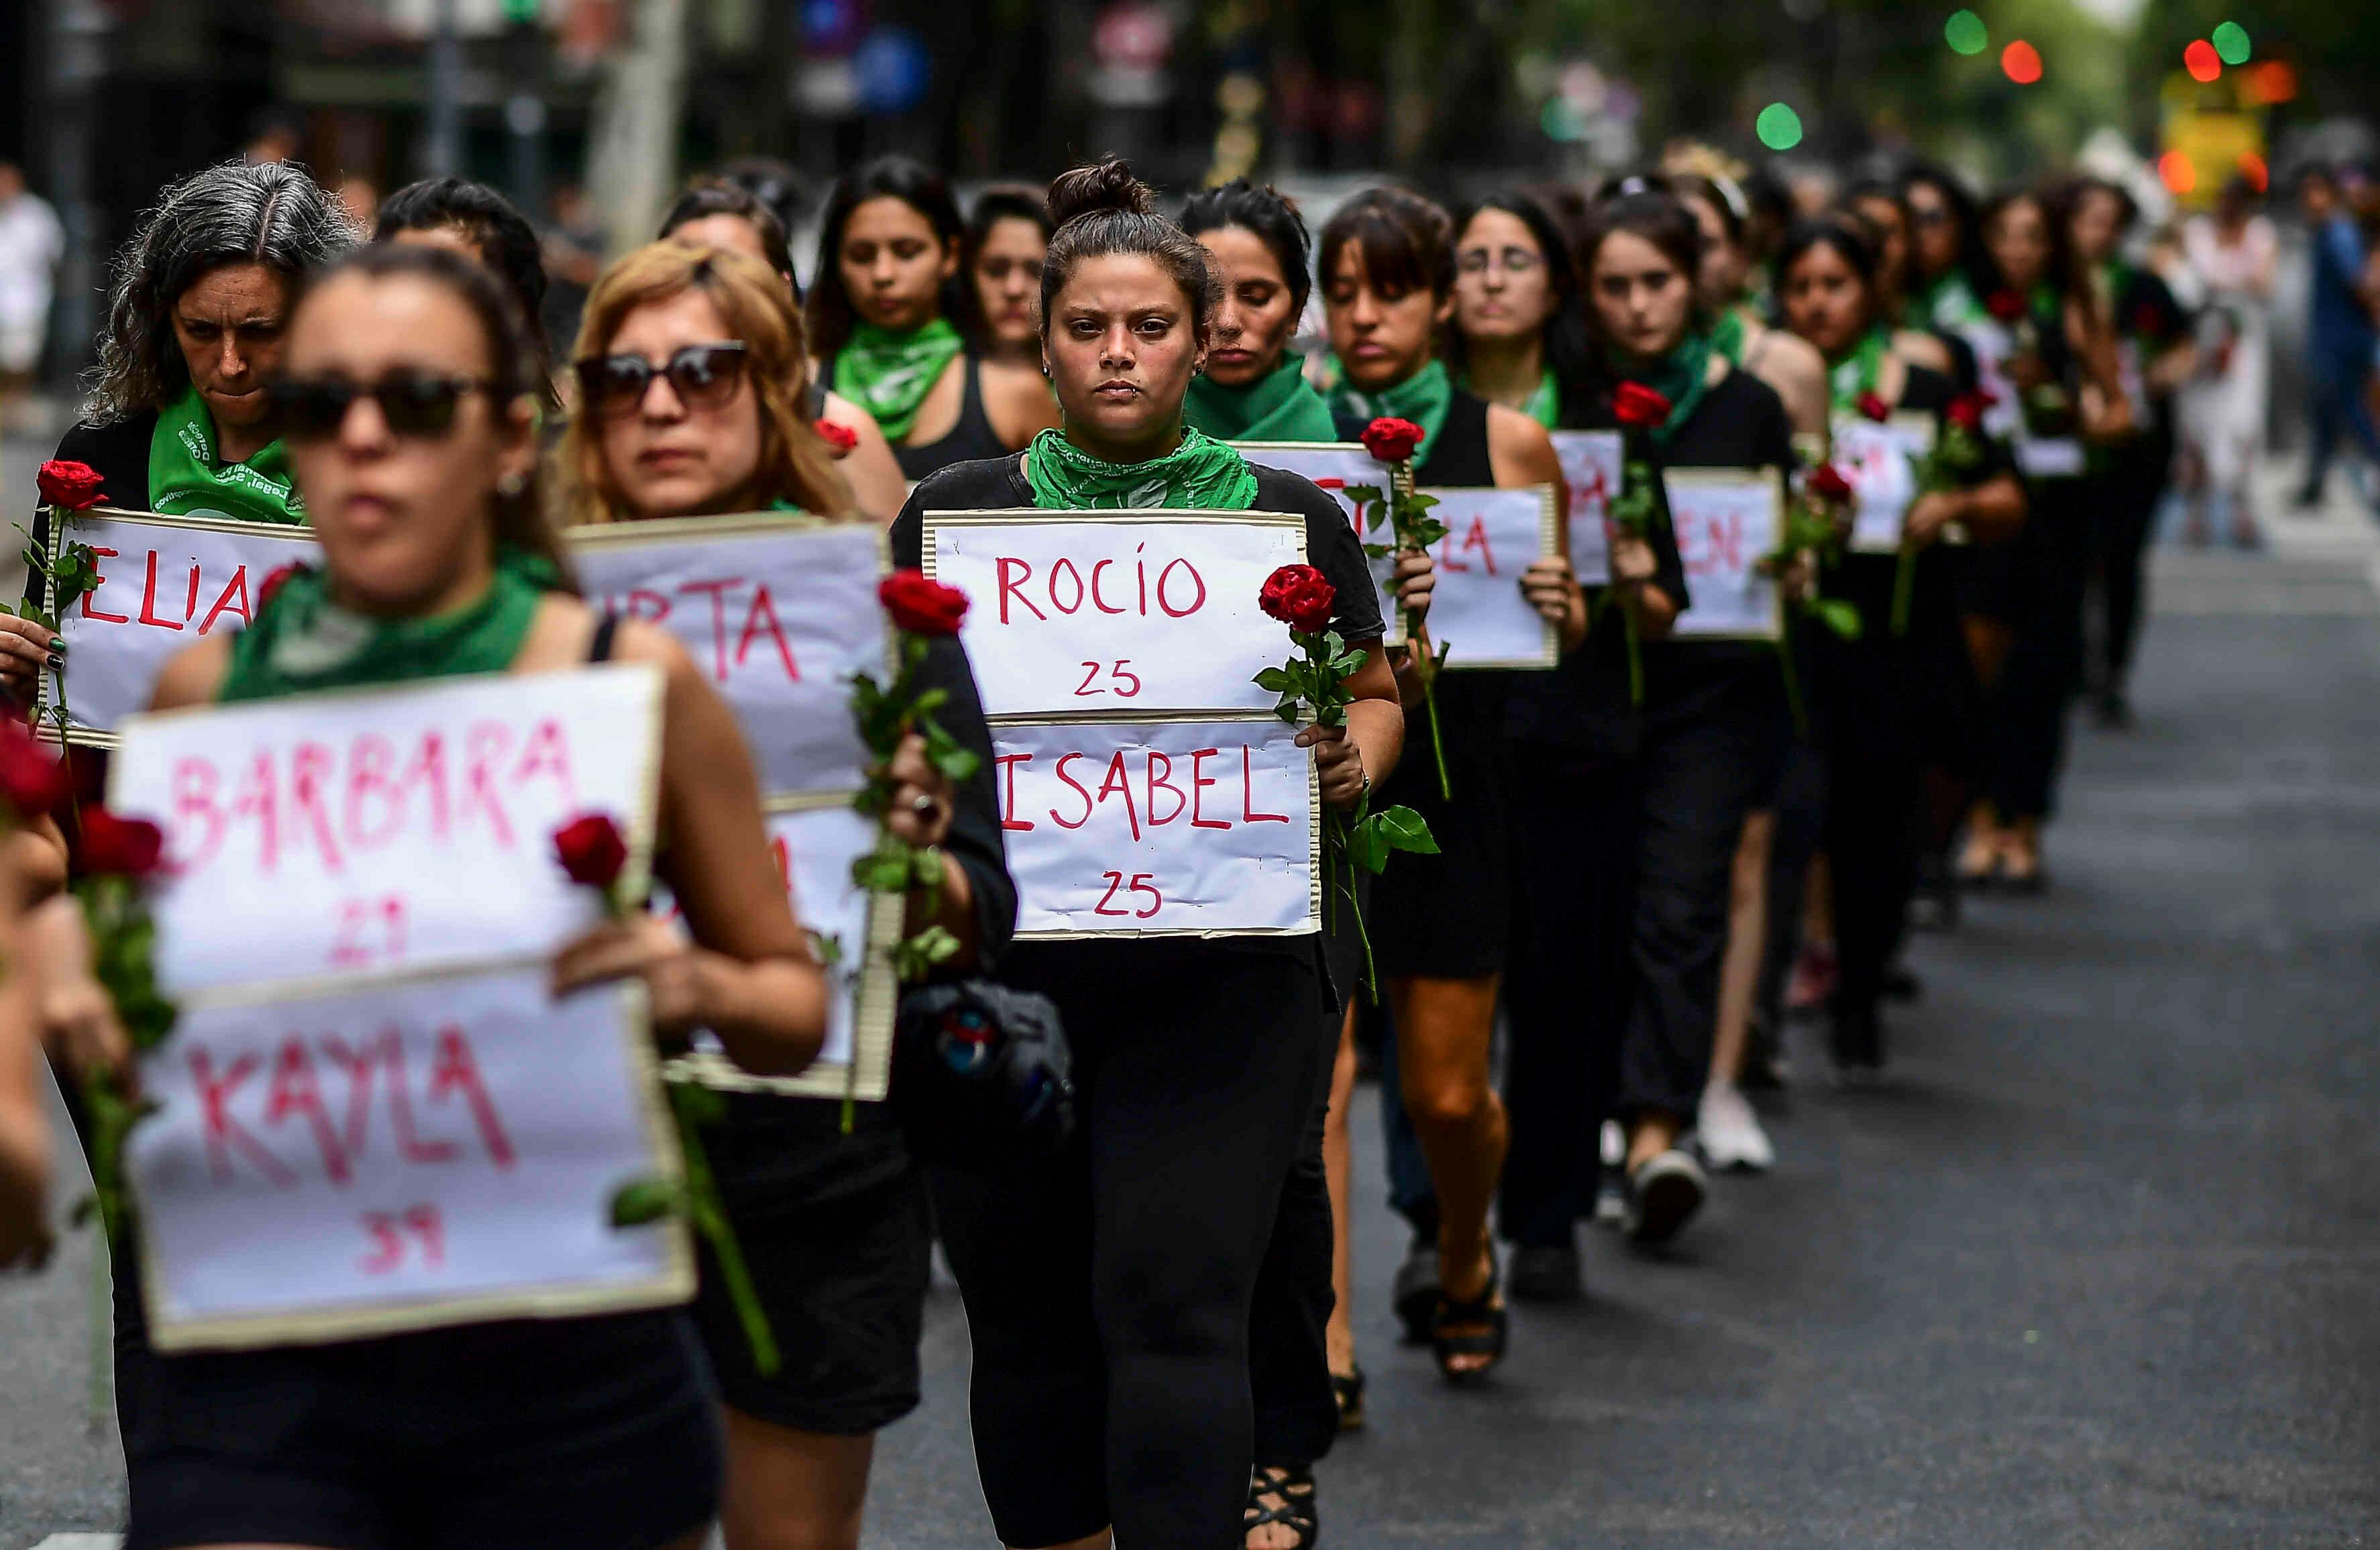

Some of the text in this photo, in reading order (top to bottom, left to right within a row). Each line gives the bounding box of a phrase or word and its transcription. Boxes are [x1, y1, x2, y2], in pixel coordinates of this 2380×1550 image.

[996, 541, 1207, 625] ROCÍO
[1073, 659, 1141, 698] 25
[170, 718, 581, 875] BARBARA
[995, 744, 1290, 842] ISABEL
[1093, 870, 1162, 919] 25
[186, 1023, 518, 1189] KAYLA
